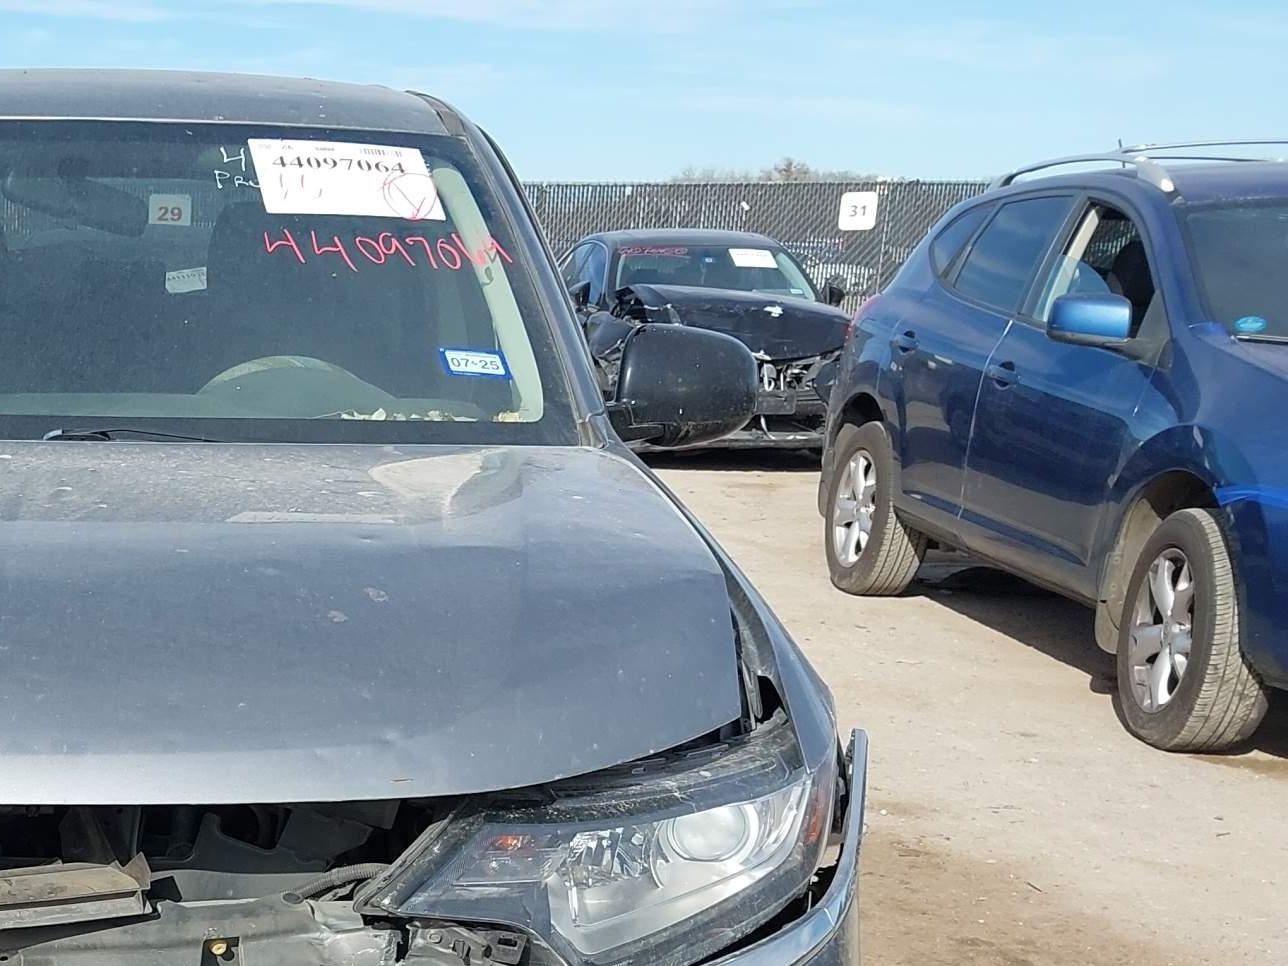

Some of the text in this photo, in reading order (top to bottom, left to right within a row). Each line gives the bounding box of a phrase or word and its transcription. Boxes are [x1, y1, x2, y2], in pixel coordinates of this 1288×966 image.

[272, 155, 406, 174] 44097064
[157, 206, 183, 222] 29
[848, 204, 867, 217] 31
